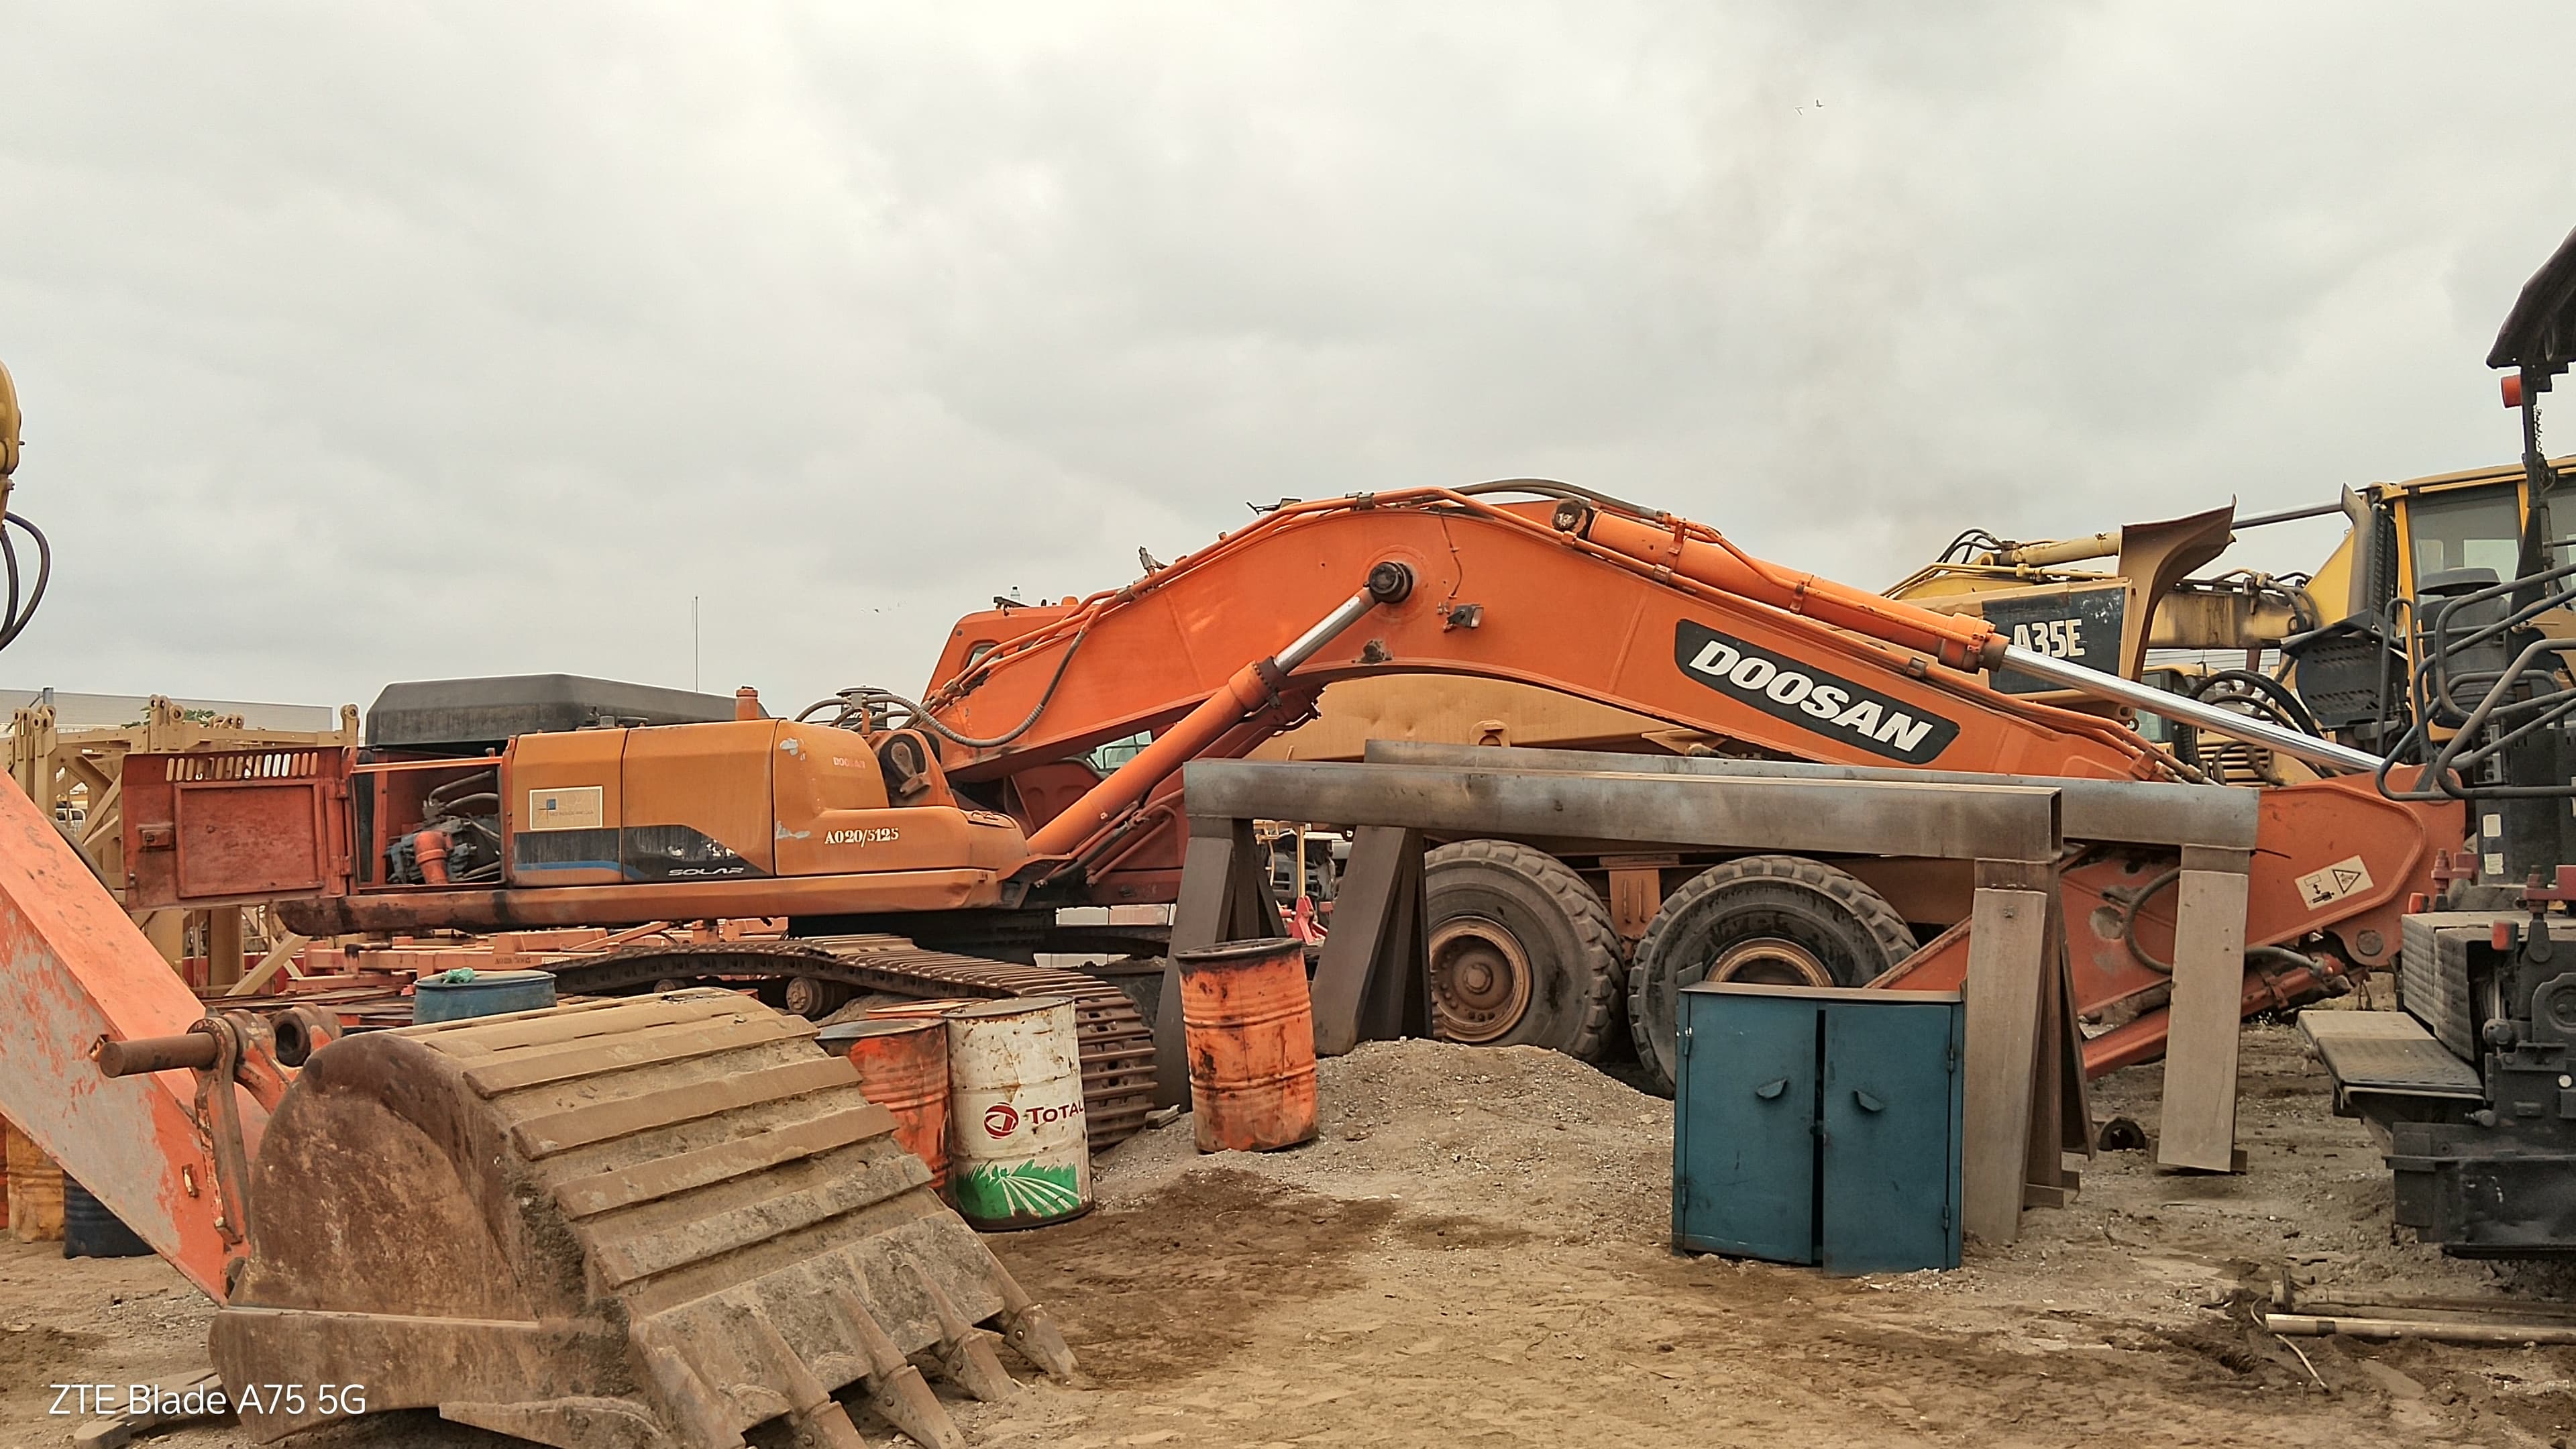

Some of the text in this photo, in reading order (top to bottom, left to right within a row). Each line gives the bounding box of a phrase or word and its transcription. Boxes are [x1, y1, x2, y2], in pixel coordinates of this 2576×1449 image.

[2015, 619, 2085, 657] A35E
[1688, 640, 1933, 752] DOOSAN
[833, 756, 866, 769] DOOAN
[668, 867, 744, 875] SOLAR
